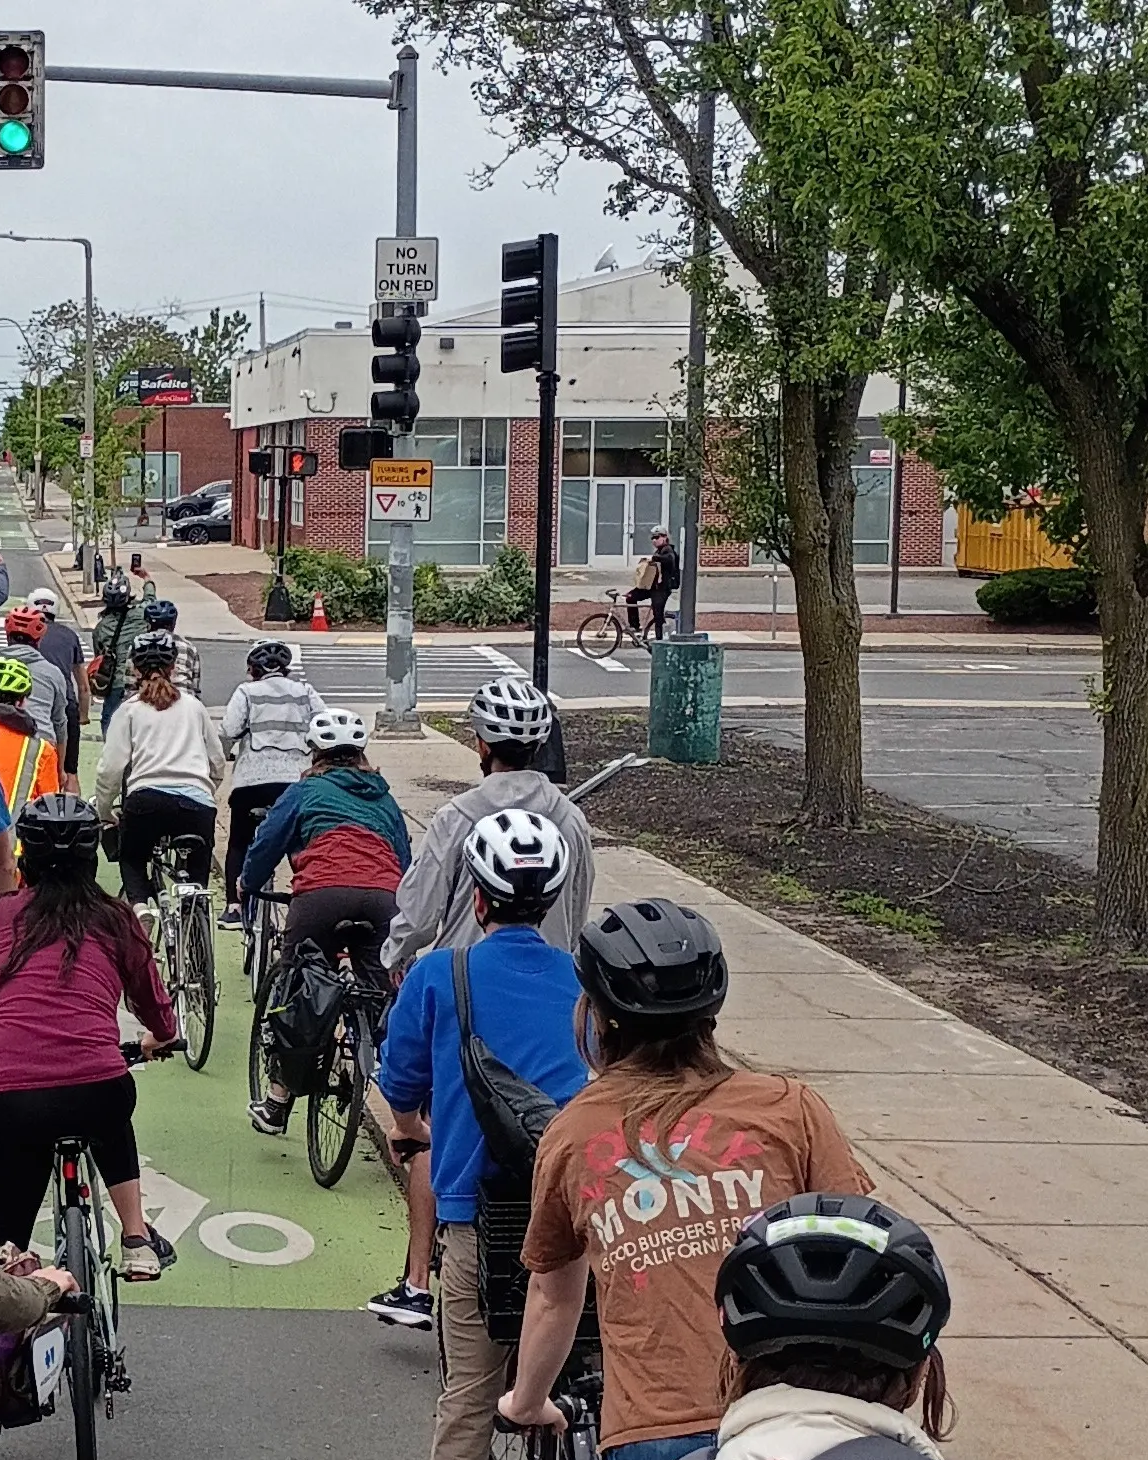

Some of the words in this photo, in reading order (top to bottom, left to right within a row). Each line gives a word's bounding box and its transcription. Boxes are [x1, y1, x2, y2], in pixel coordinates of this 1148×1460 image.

[396, 247, 417, 259] NO
[386, 263, 427, 275] TURN
[378, 279, 400, 291] ON
[404, 279, 434, 291] RED
[590, 1169, 764, 1250] MONTY
[638, 1220, 716, 1251] BURGERS
[630, 1236, 735, 1272] CALIFORNIA
